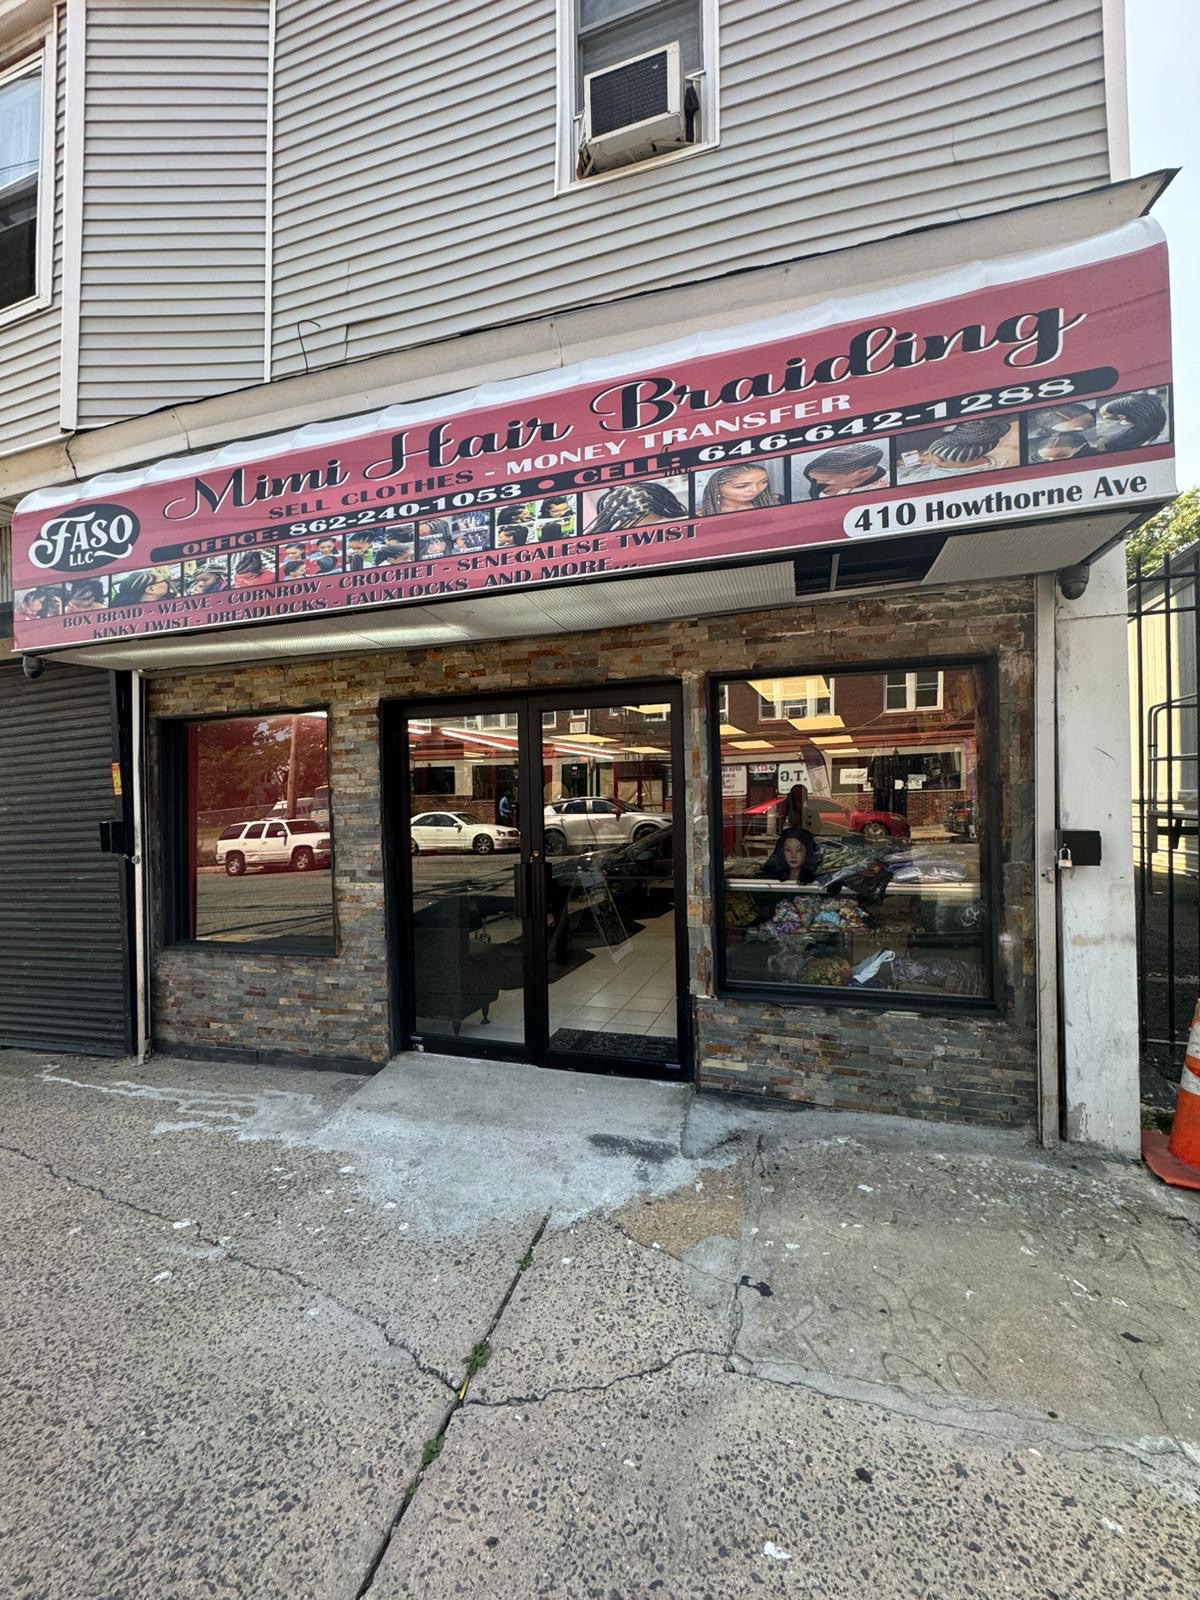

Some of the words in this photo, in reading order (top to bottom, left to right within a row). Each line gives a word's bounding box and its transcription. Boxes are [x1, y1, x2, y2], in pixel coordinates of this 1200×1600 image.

[163, 459, 351, 521] Mimi
[363, 422, 573, 481] Hair
[589, 308, 1087, 432] Braiding
[269, 500, 331, 519] SELL
[341, 470, 474, 505] CLOTHES
[507, 439, 626, 475] MONEY
[638, 395, 851, 449] TRANSFER
[183, 529, 279, 555] OFFICE:
[290, 484, 521, 536] 862-240-1053
[574, 457, 681, 484] CELL:
[698, 378, 1075, 462] 646-642-1288
[855, 503, 916, 531] 410
[925, 487, 1083, 522] Howthorne
[1093, 475, 1147, 499] Ave
[28, 511, 133, 568] FASO
[63, 615, 93, 628] BOX
[97, 607, 143, 623] BRAID
[158, 597, 212, 615] WEAVE
[228, 581, 321, 605] CORNROW
[339, 563, 437, 590] CROCHET
[458, 538, 609, 572] SENEGALESE
[616, 524, 702, 548] TWIST
[69, 552, 94, 567] LLC
[93, 627, 138, 639] KINKY
[144, 616, 193, 635] TWIST
[207, 597, 327, 625] DREADLOCKS
[346, 578, 468, 605] FAUXLOCKS
[485, 570, 534, 588] AND
